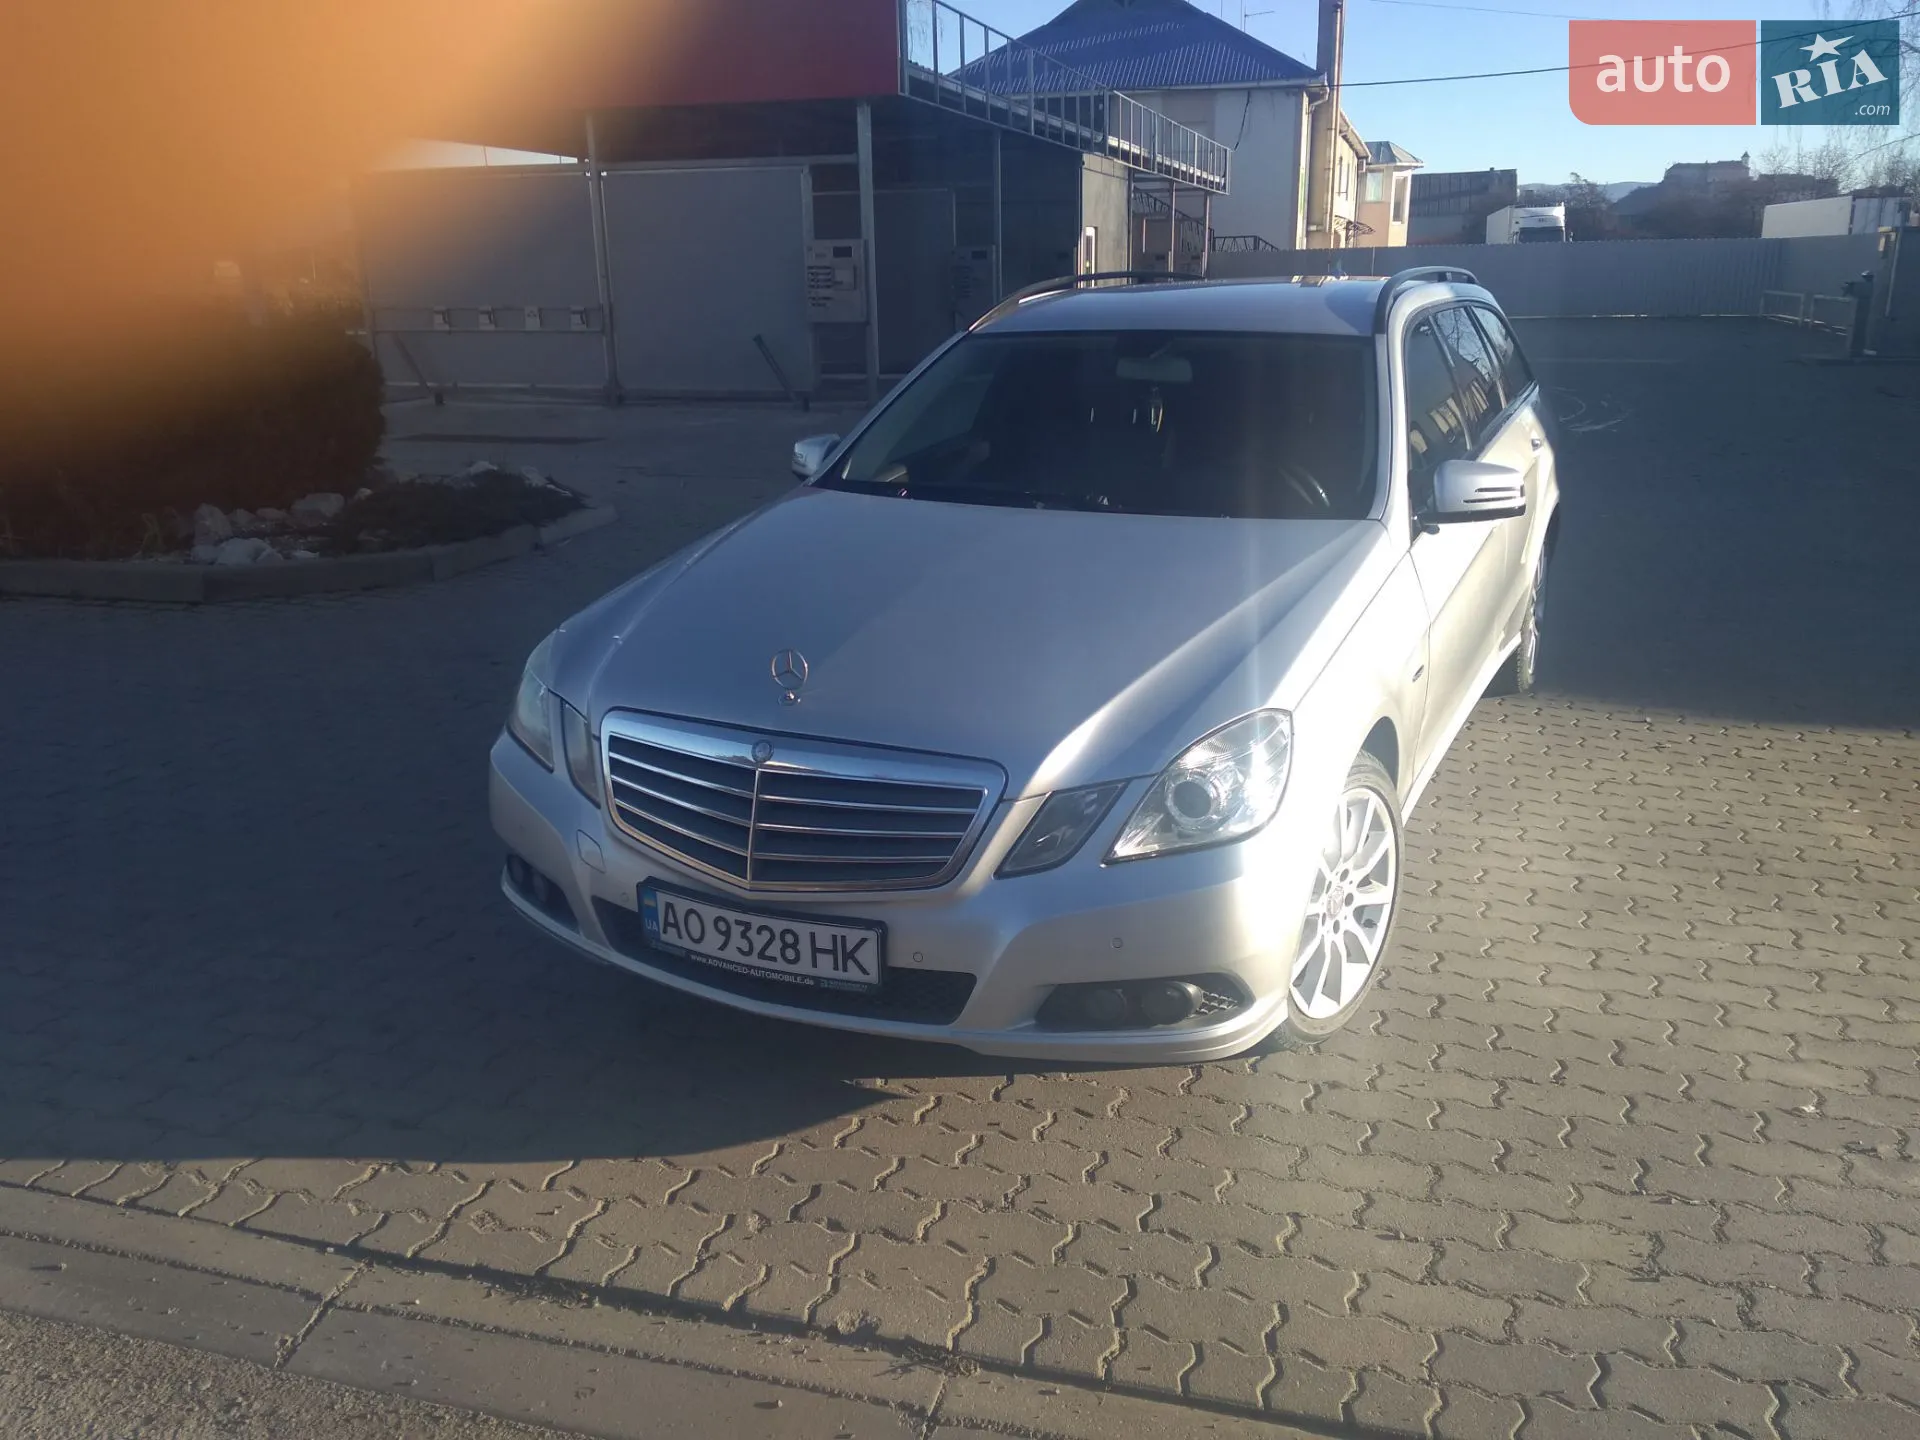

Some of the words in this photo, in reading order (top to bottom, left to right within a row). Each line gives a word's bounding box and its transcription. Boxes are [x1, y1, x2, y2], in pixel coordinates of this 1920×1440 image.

[645, 918, 659, 932] UA
[661, 901, 706, 945] AO
[713, 915, 801, 966] 9328
[809, 931, 871, 977] HK
